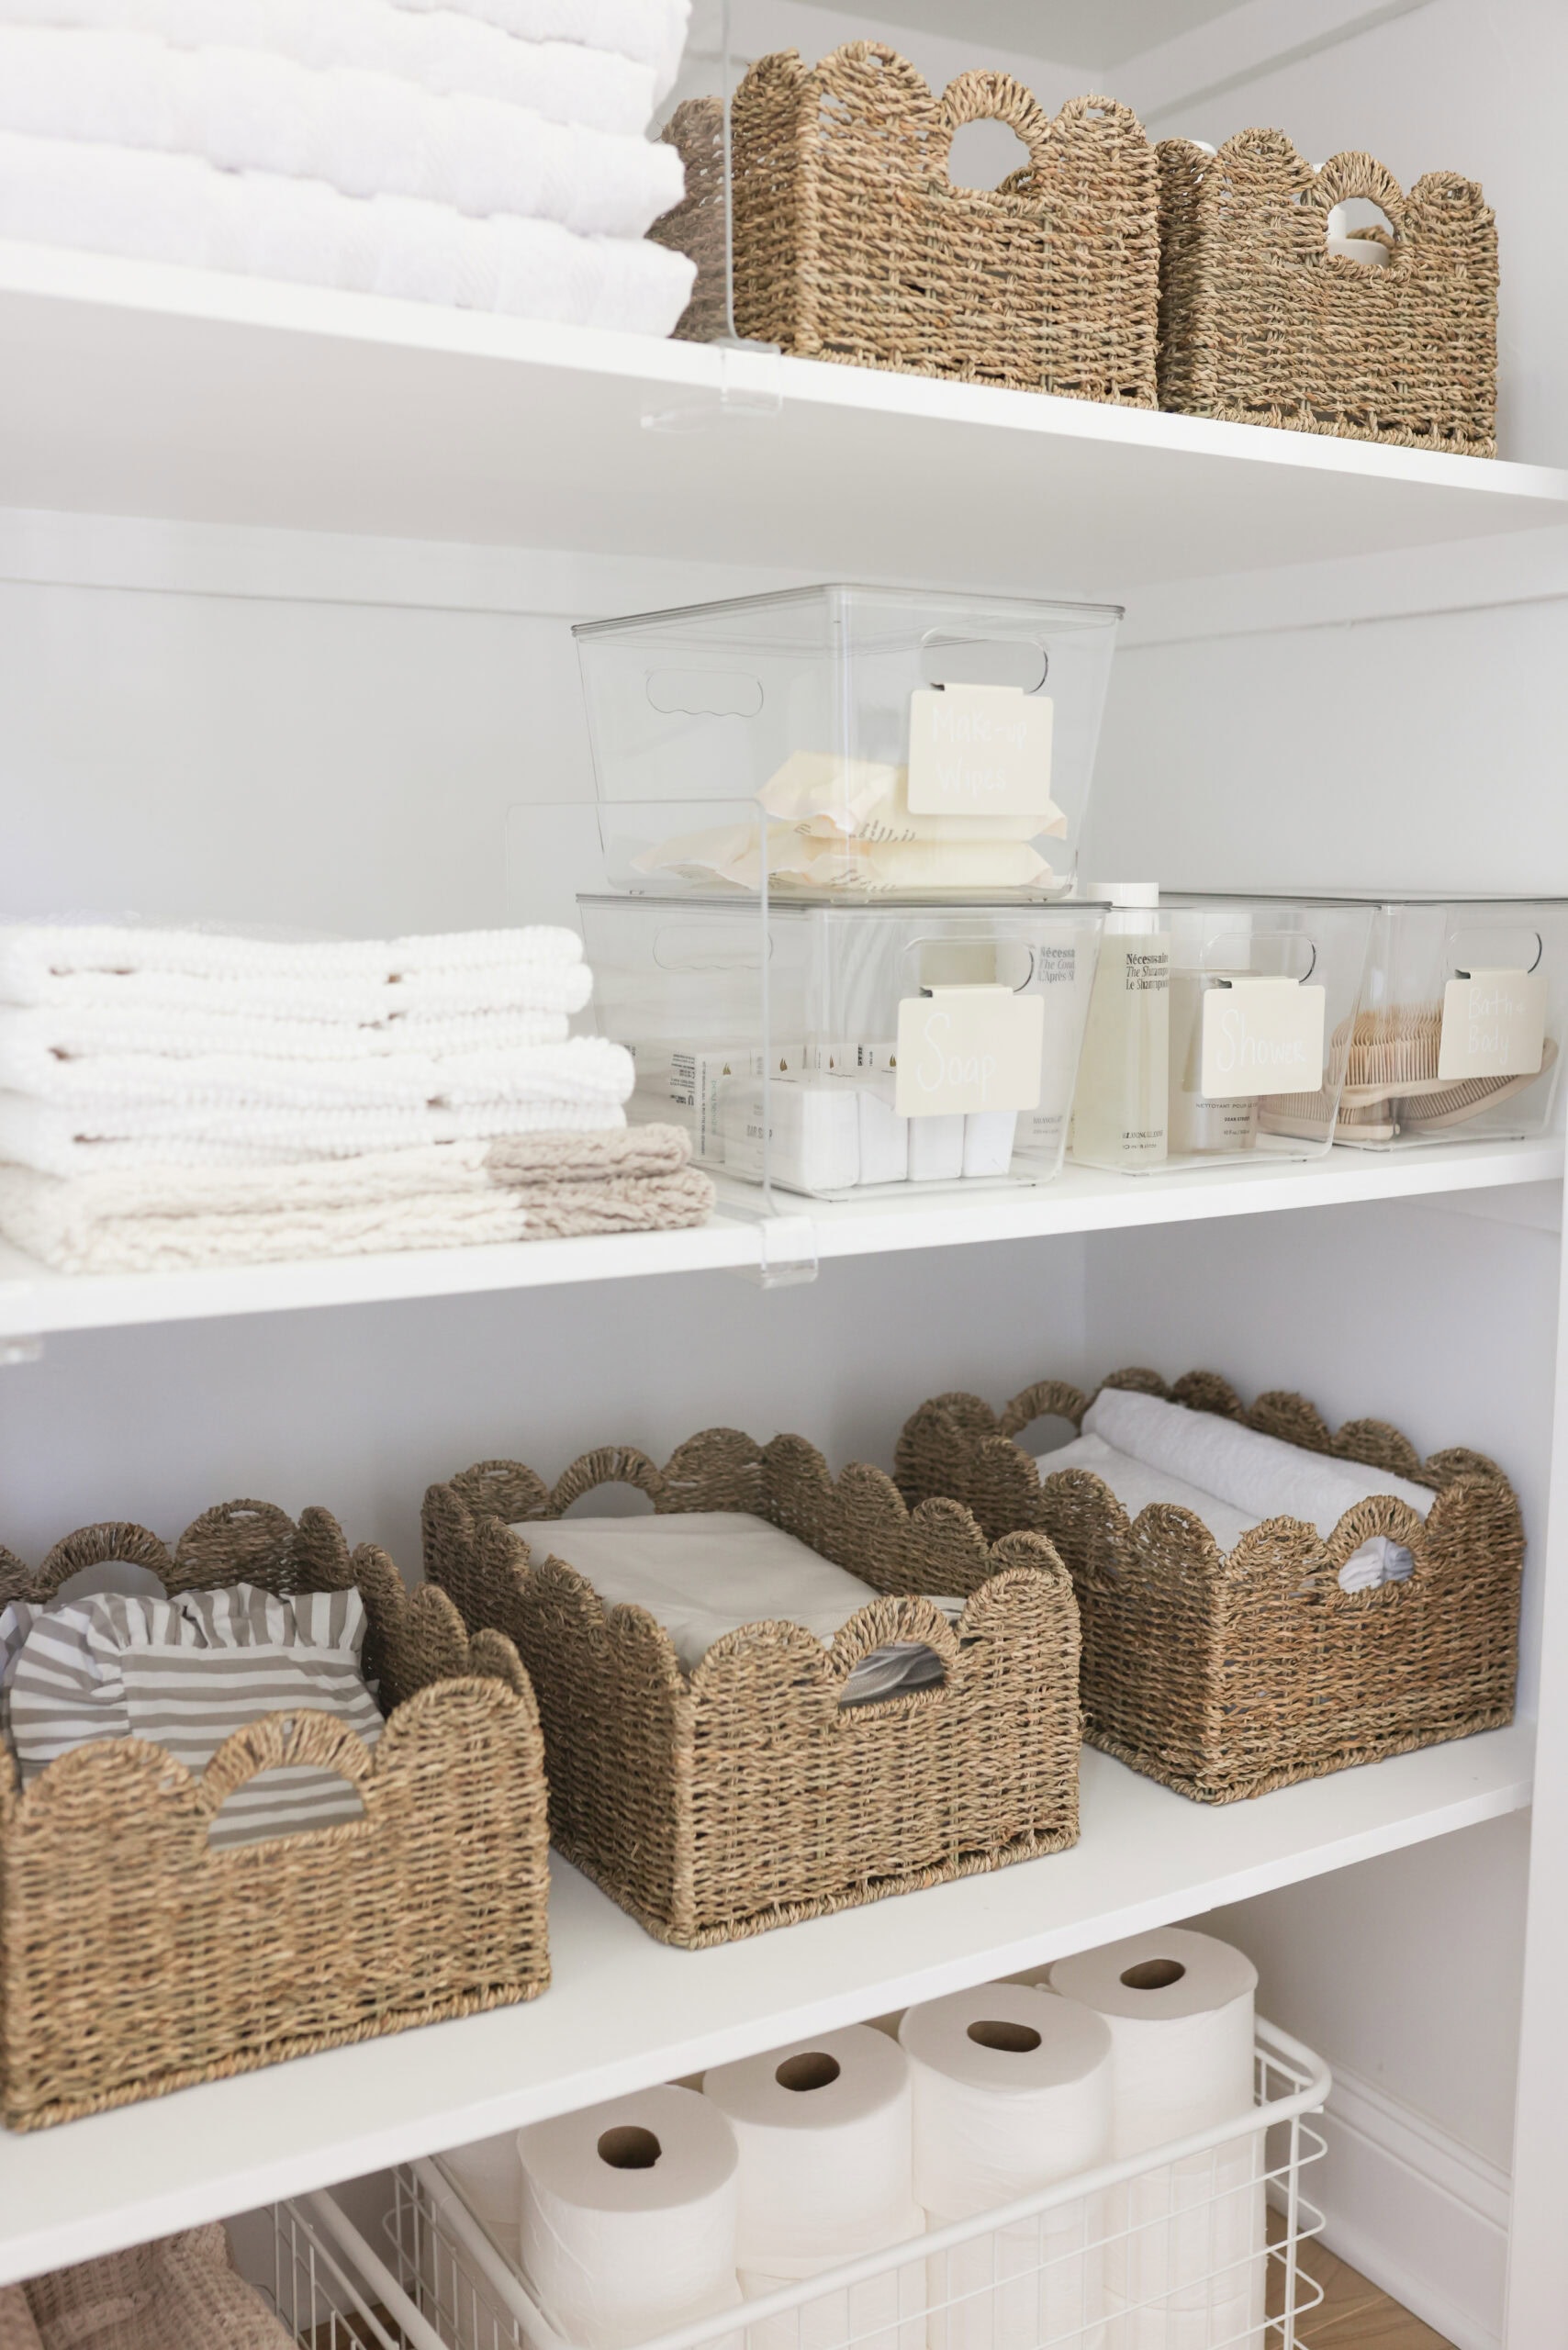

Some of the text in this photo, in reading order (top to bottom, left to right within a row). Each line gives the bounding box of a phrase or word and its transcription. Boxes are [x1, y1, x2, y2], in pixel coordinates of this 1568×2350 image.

[935, 755, 1006, 799] Wipes
[1126, 966, 1141, 978] The
[1126, 979, 1135, 990] Le
[1468, 987, 1513, 1020] Bath
[915, 1012, 997, 1102] Soap
[1468, 1024, 1510, 1065] Body
